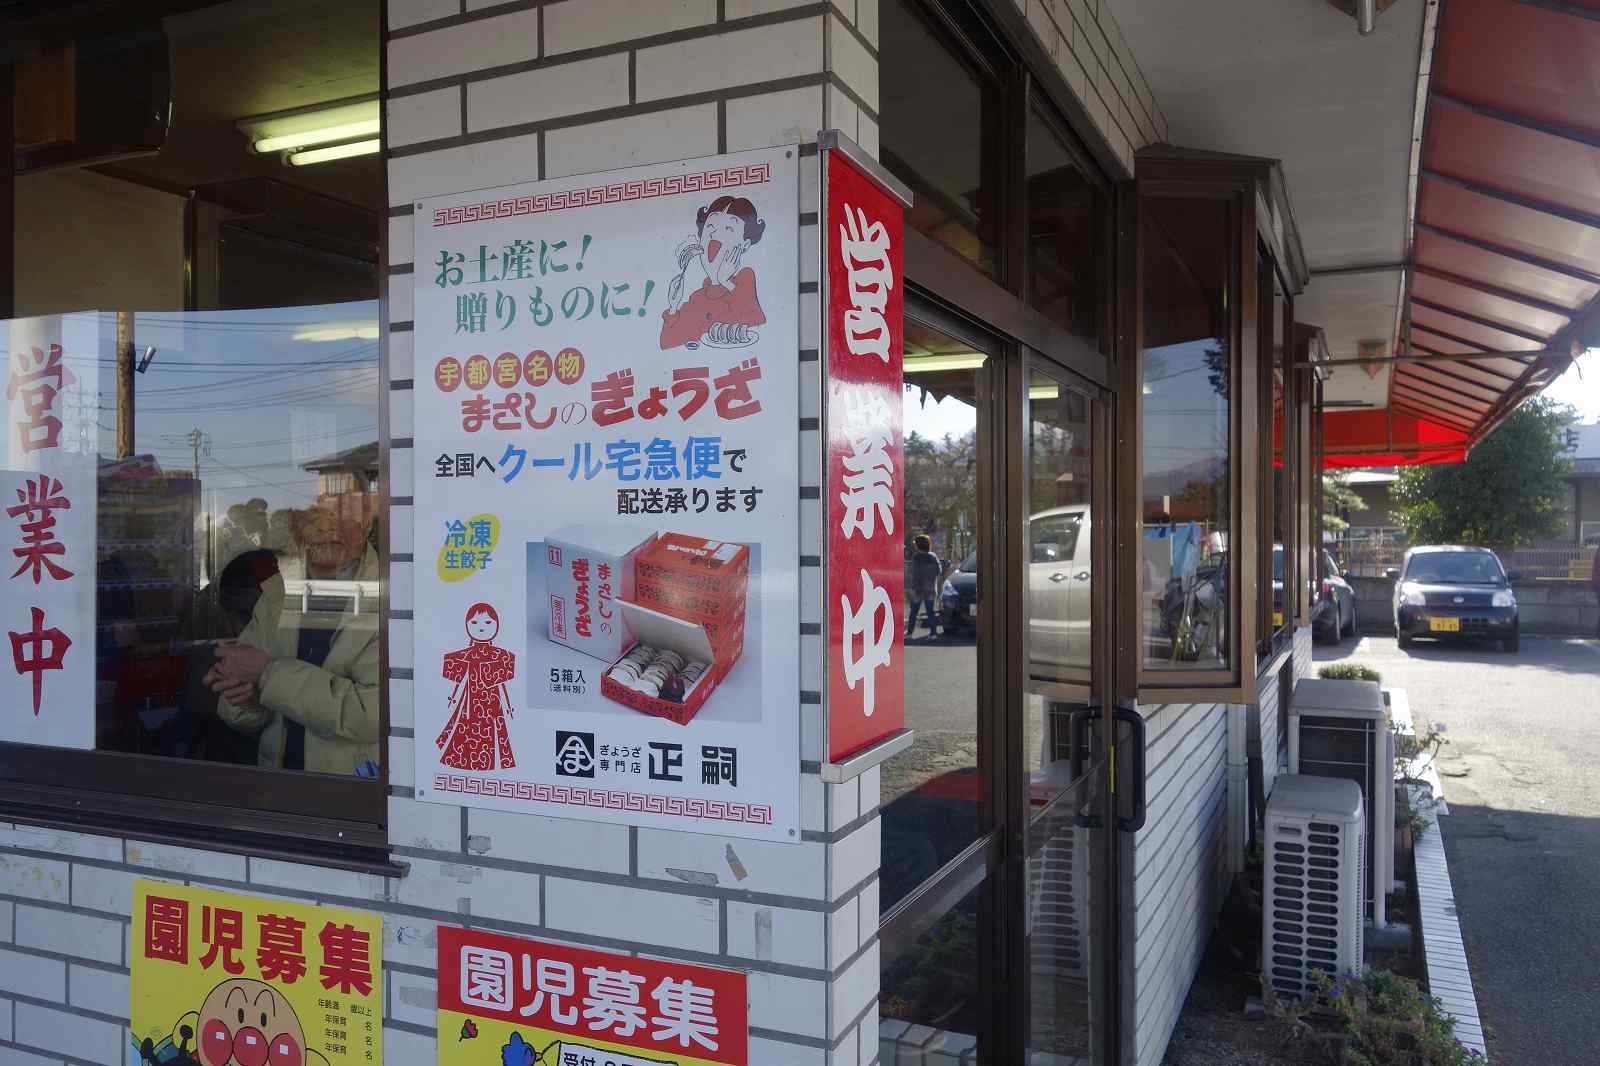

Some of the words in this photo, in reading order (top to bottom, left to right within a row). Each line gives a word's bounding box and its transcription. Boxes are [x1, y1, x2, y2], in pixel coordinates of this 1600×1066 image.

[434, 234, 592, 289] お土産に！
[455, 280, 655, 335] 贈りものに！
[438, 351, 581, 388] 宇都宮名物
[435, 436, 749, 484] 全国へクール宅急便で
[616, 486, 763, 515] 配送承ります
[6, 342, 76, 717] 営業中
[444, 519, 493, 548] 冷凍
[444, 550, 493, 570] 生餃子
[550, 668, 586, 684] 5箱入
[600, 744, 641, 758] ぎょうざ
[600, 759, 641, 774] 専門店
[144, 894, 373, 997] 園児募集
[460, 945, 719, 1051] 園児募集
